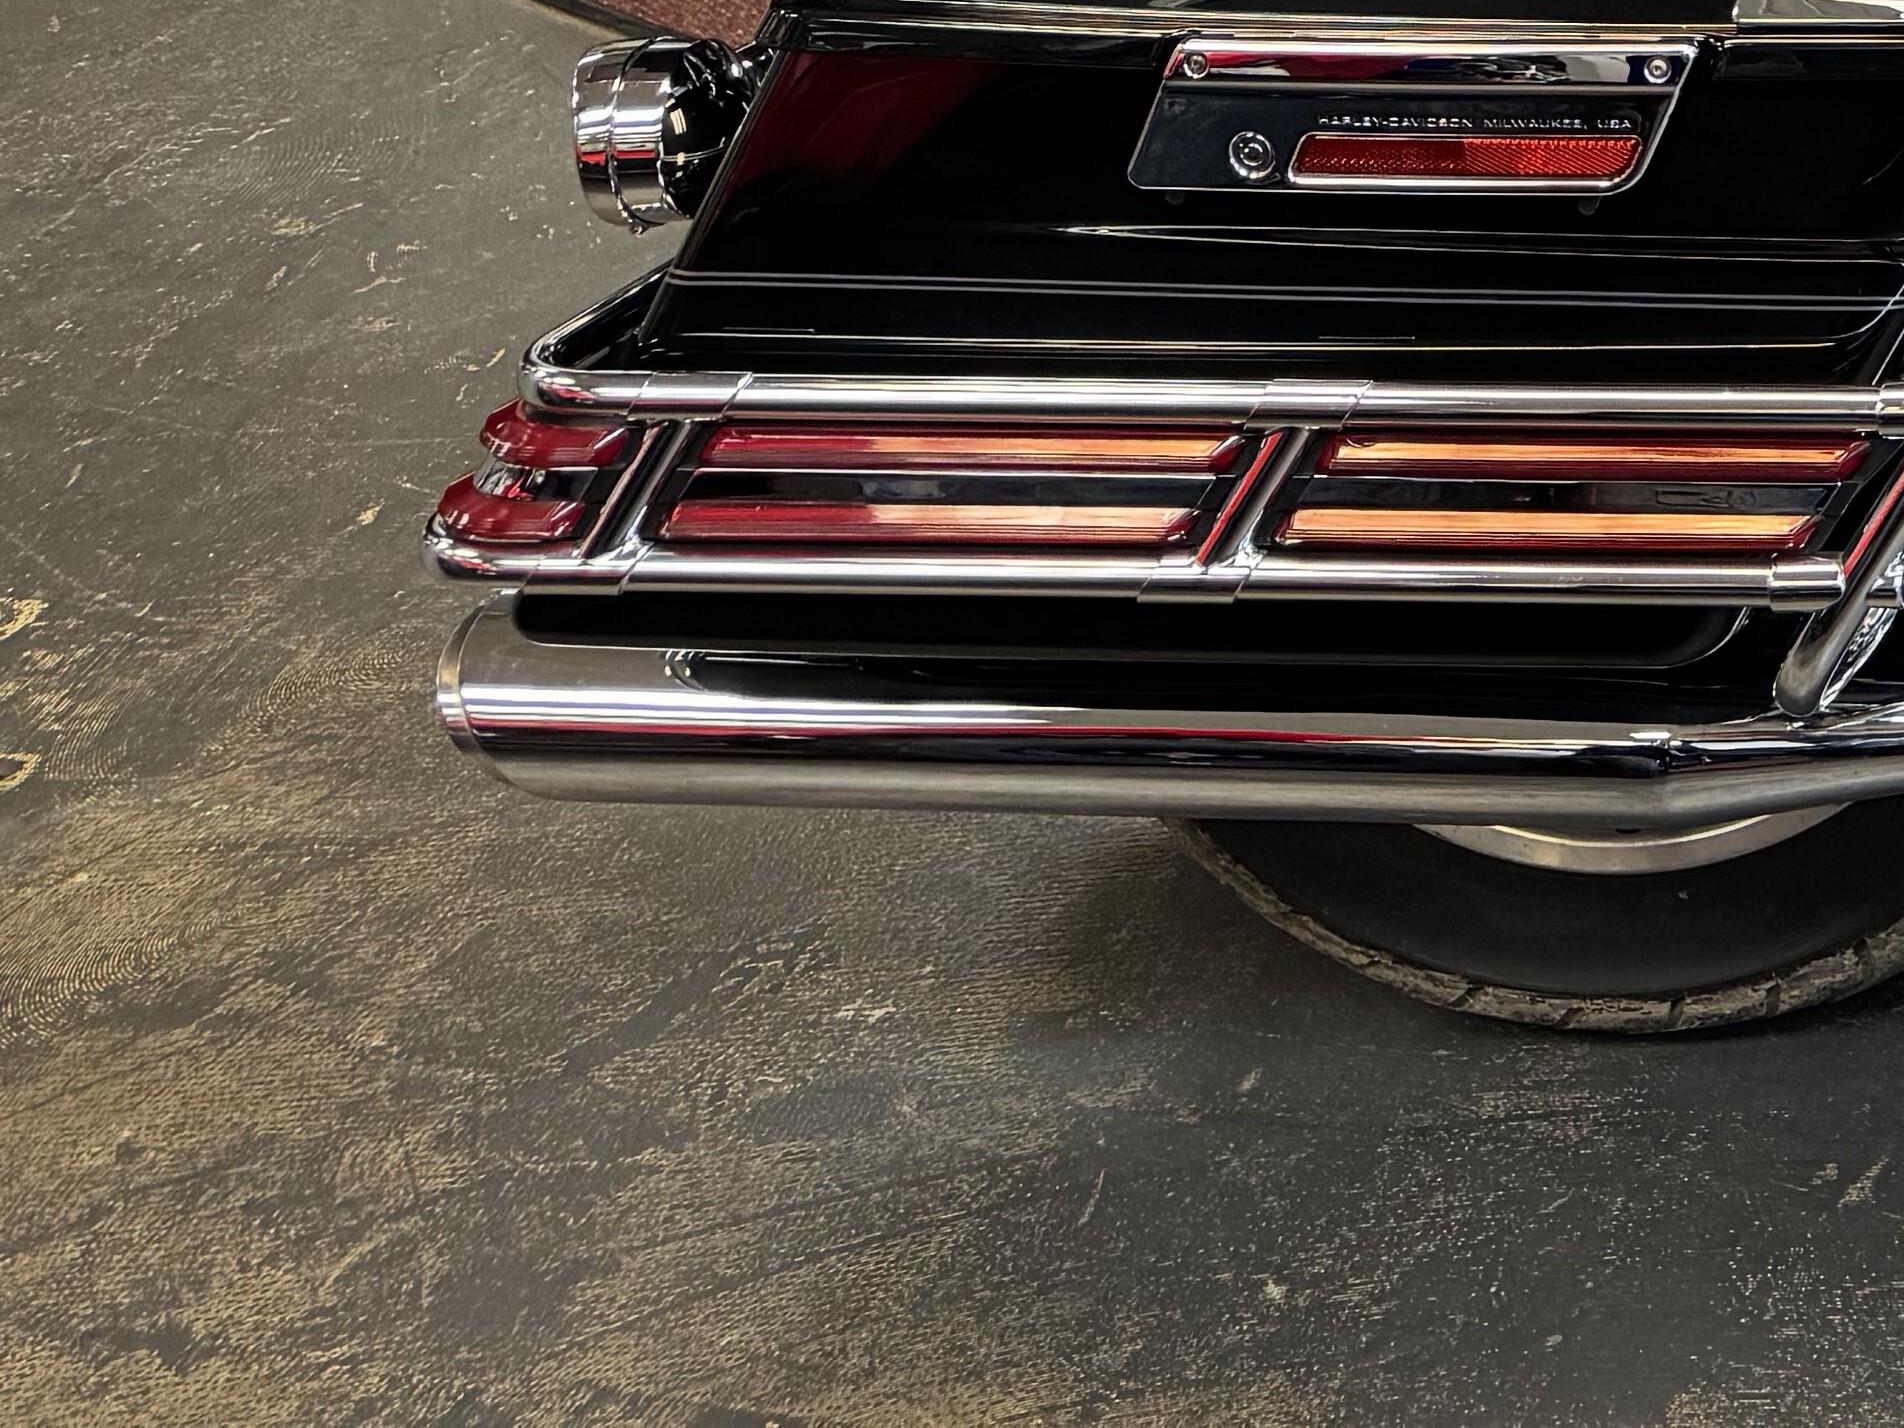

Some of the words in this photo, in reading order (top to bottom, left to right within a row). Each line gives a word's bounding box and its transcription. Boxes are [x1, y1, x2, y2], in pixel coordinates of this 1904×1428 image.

[1317, 115, 1475, 128] HARLEY-DAVIDSON
[1482, 117, 1588, 132] MILWAUKEE,
[1597, 118, 1632, 130] USA
